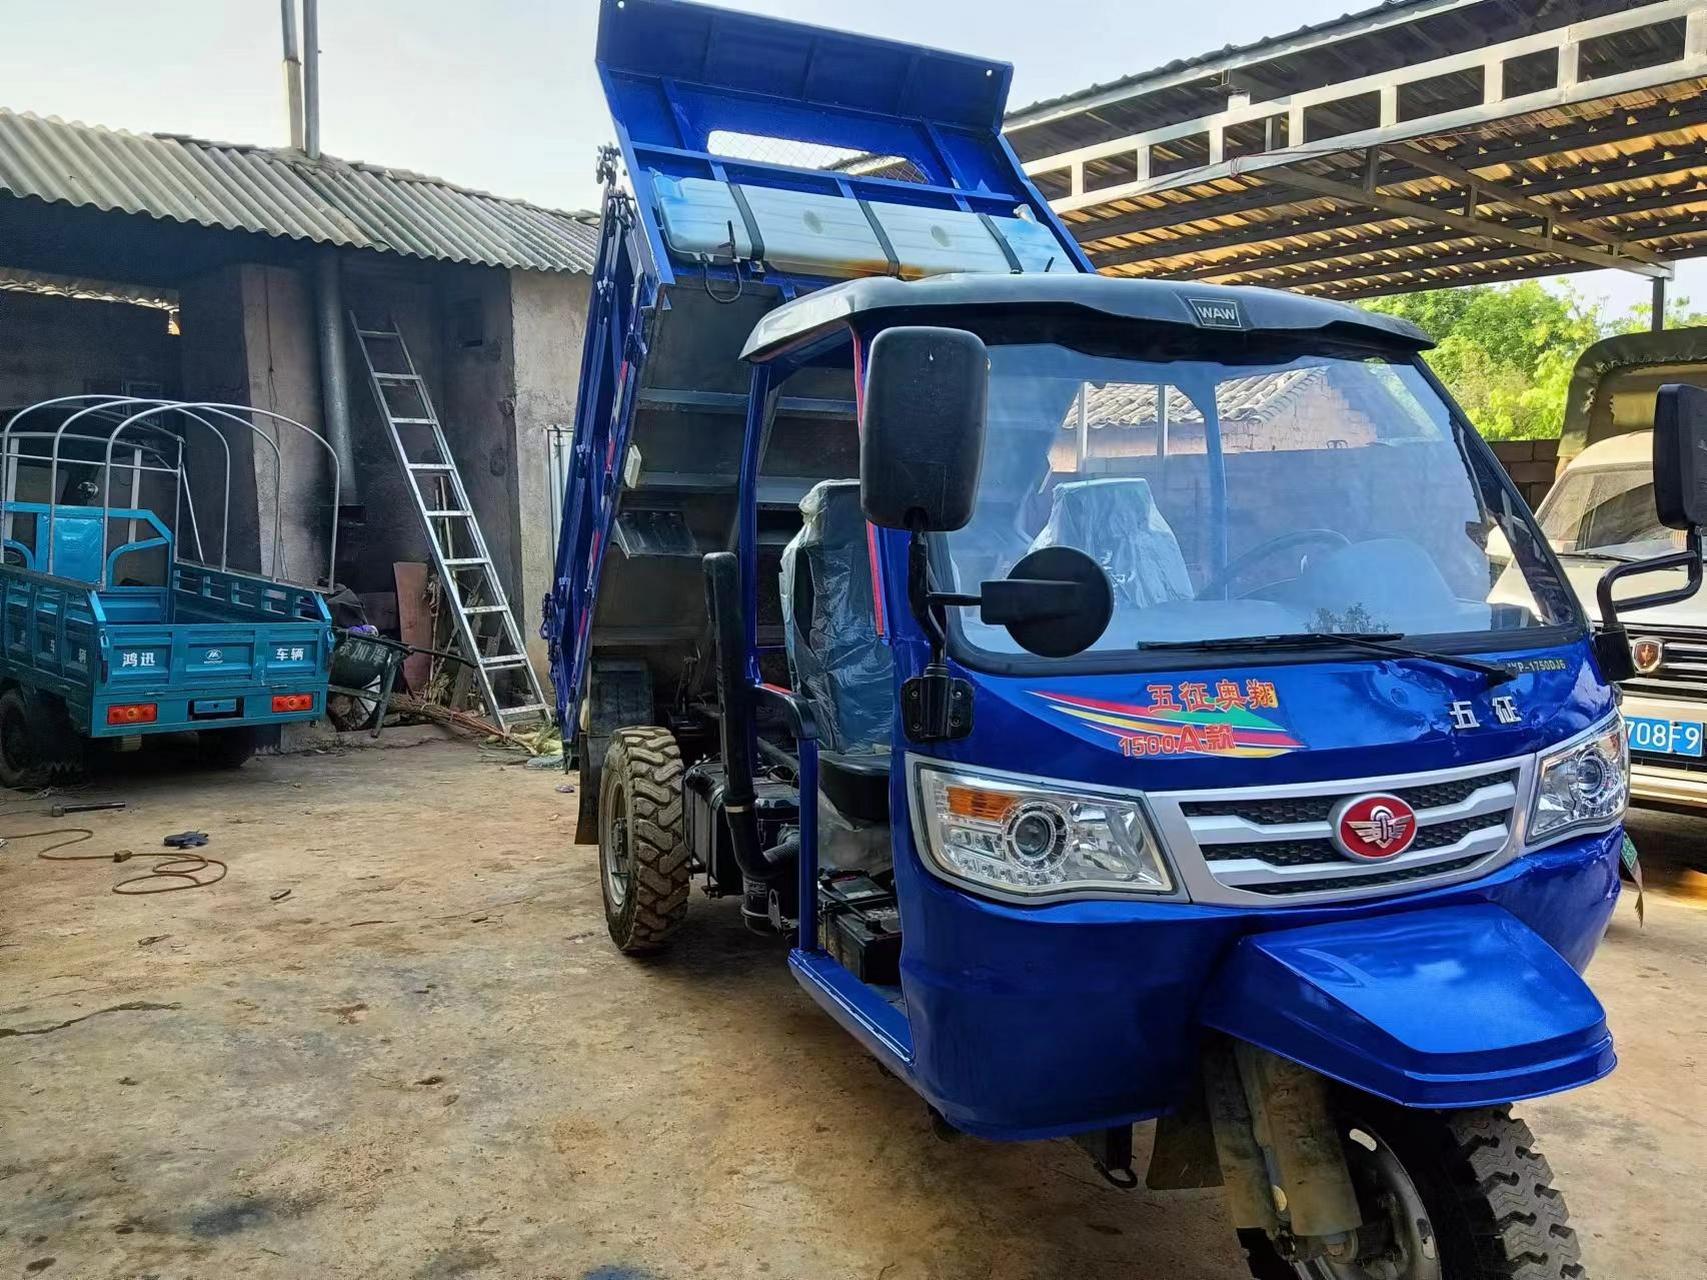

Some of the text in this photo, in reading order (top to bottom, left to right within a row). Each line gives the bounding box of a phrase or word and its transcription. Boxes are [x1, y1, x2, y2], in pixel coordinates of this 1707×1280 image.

[1198, 306, 1236, 320] WAW
[122, 647, 305, 668] 鸿迅 车辆
[1146, 678, 1279, 713] 五征奥翔
